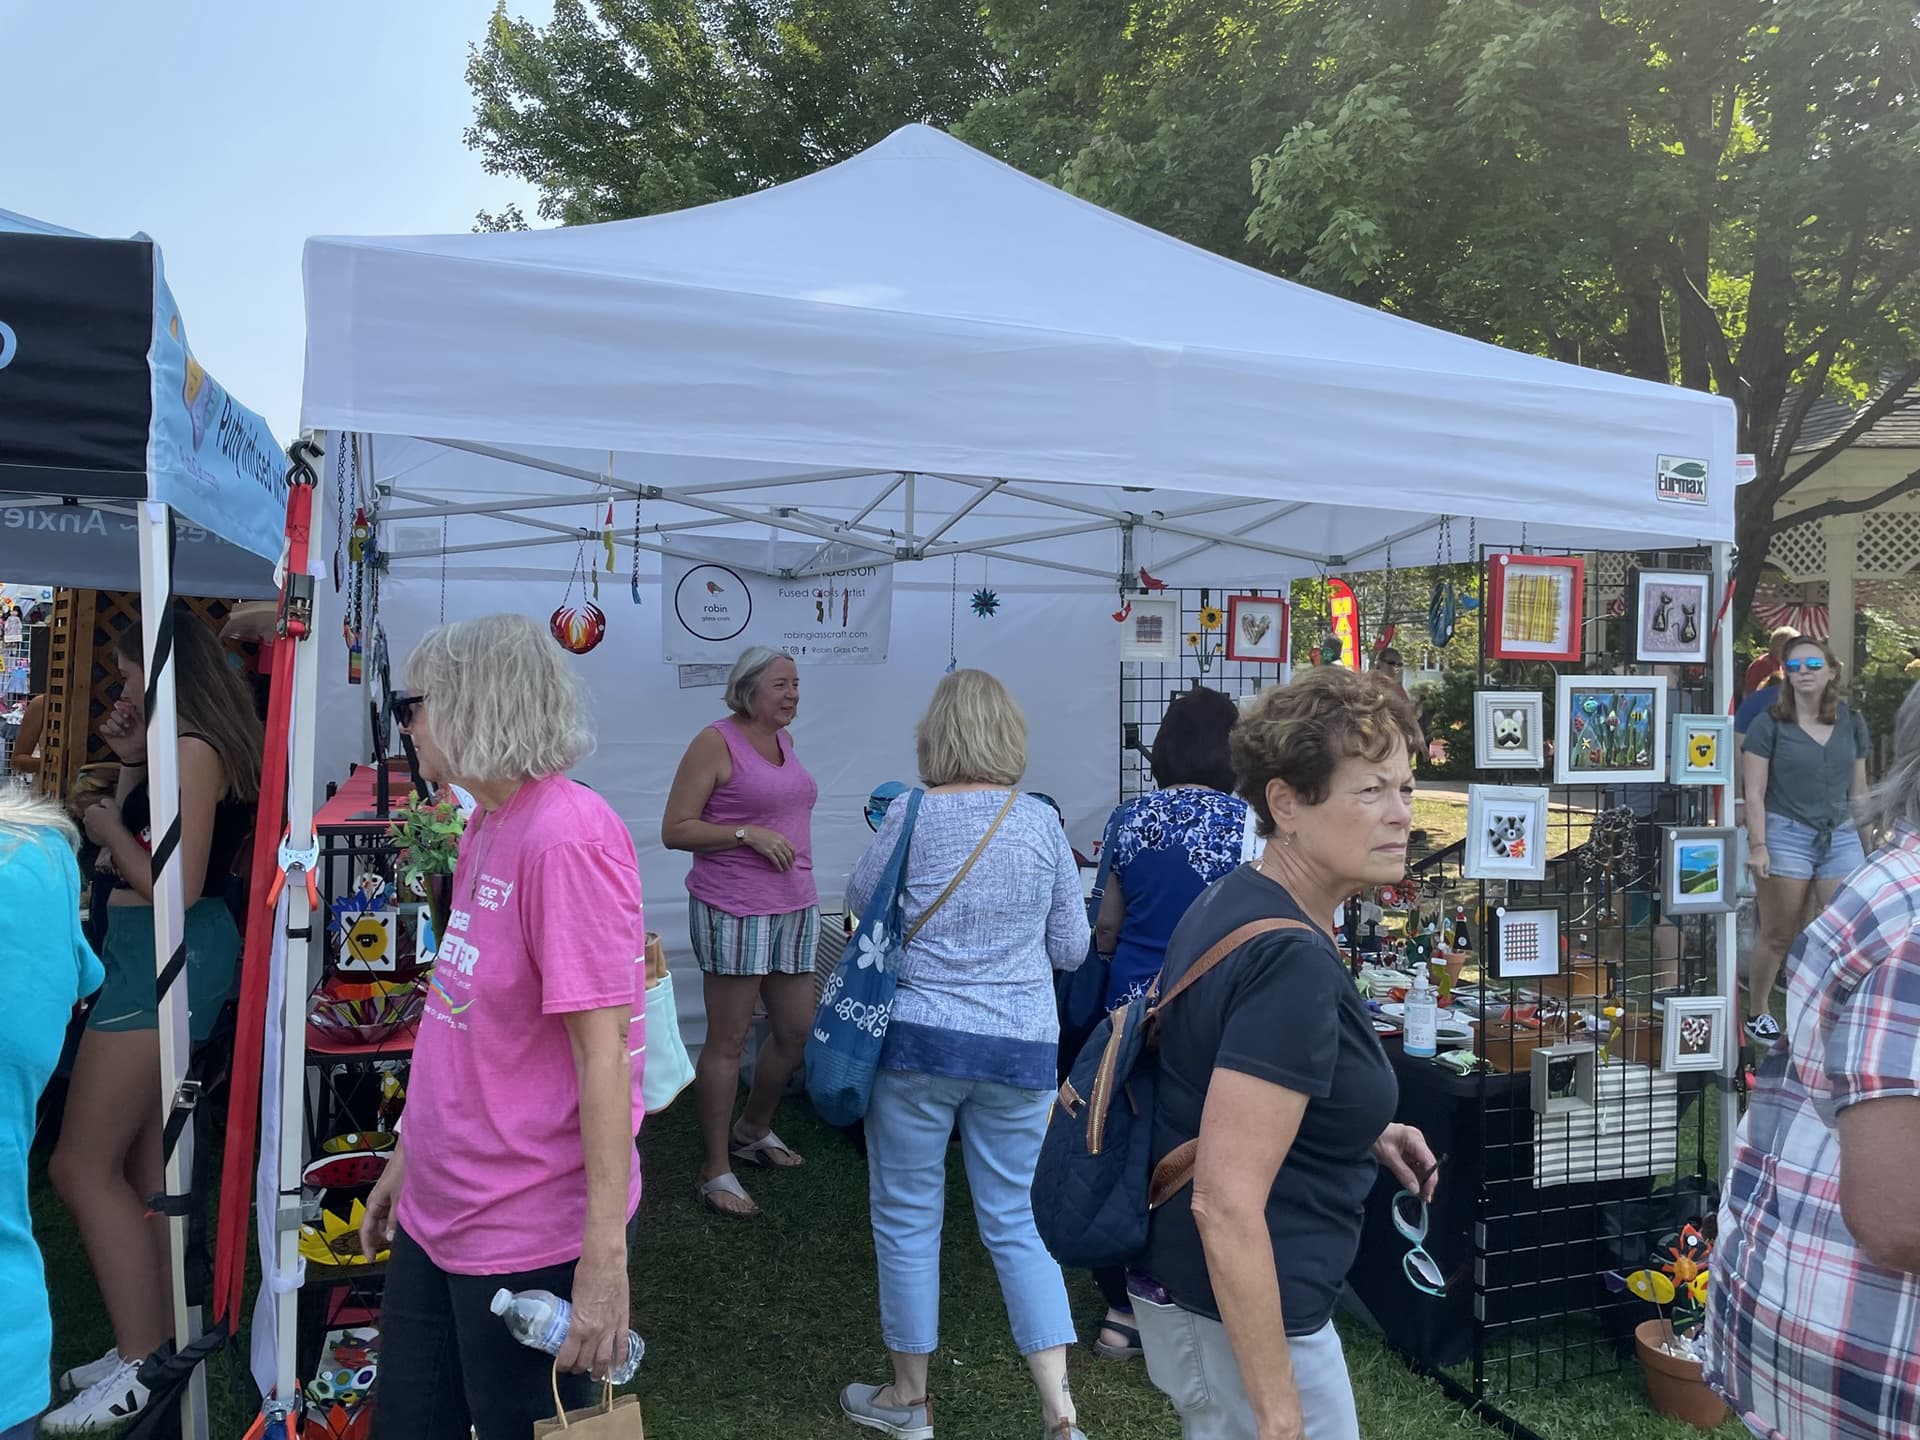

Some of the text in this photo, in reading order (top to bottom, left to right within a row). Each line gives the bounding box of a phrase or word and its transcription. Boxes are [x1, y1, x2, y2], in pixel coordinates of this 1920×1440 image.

[216, 393, 246, 479] Putty
[1658, 473, 1704, 495] Eurmax
[778, 588, 809, 598] Fused
[703, 603, 728, 613] robin
[784, 631, 868, 641] robinglasscraft.com
